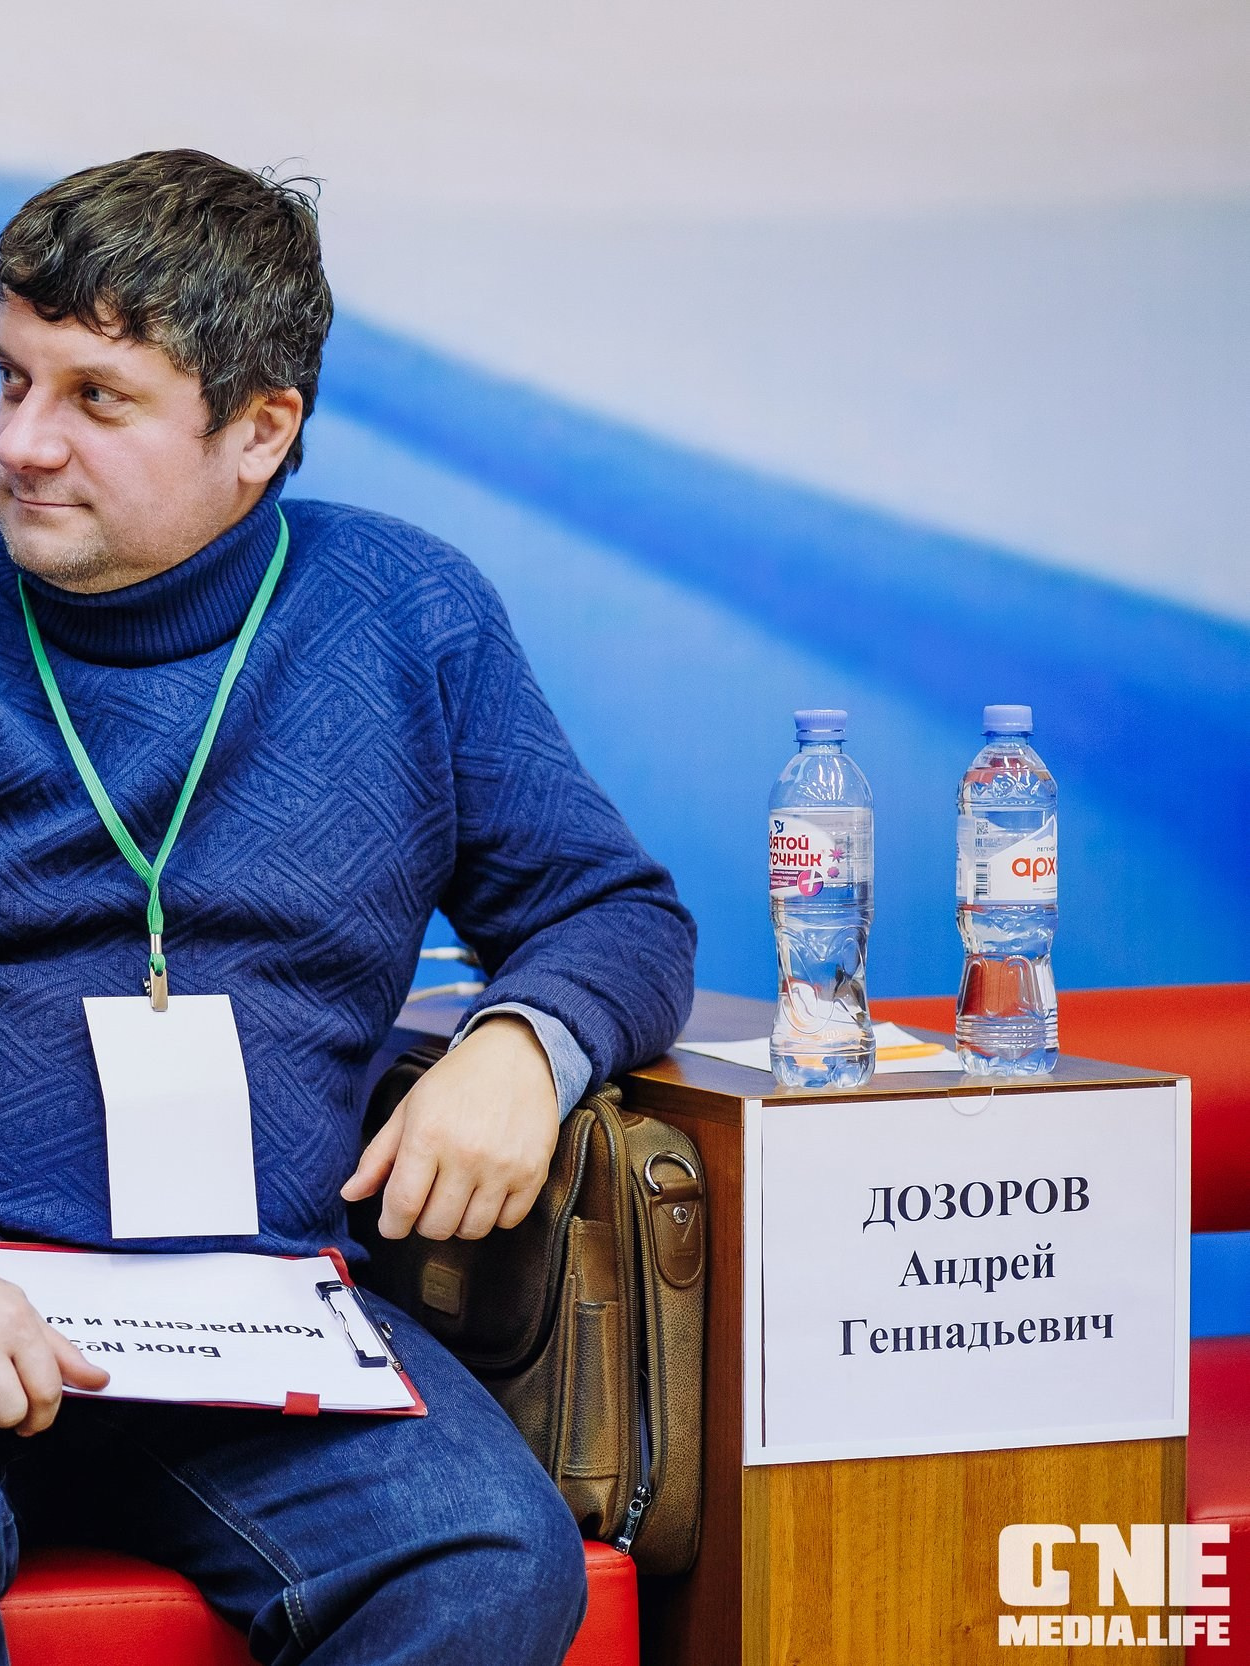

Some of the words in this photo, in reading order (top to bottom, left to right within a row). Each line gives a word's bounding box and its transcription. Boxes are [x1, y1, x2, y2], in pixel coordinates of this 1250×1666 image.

[862, 1176, 1091, 1234] ДОЗОРОВ
[898, 1242, 1056, 1293] Андрей
[83, 1317, 103, 1326] и
[113, 1317, 325, 1339] Контрагенты
[838, 1313, 1114, 1357] Геннадьевич
[136, 1342, 222, 1358] Блок
